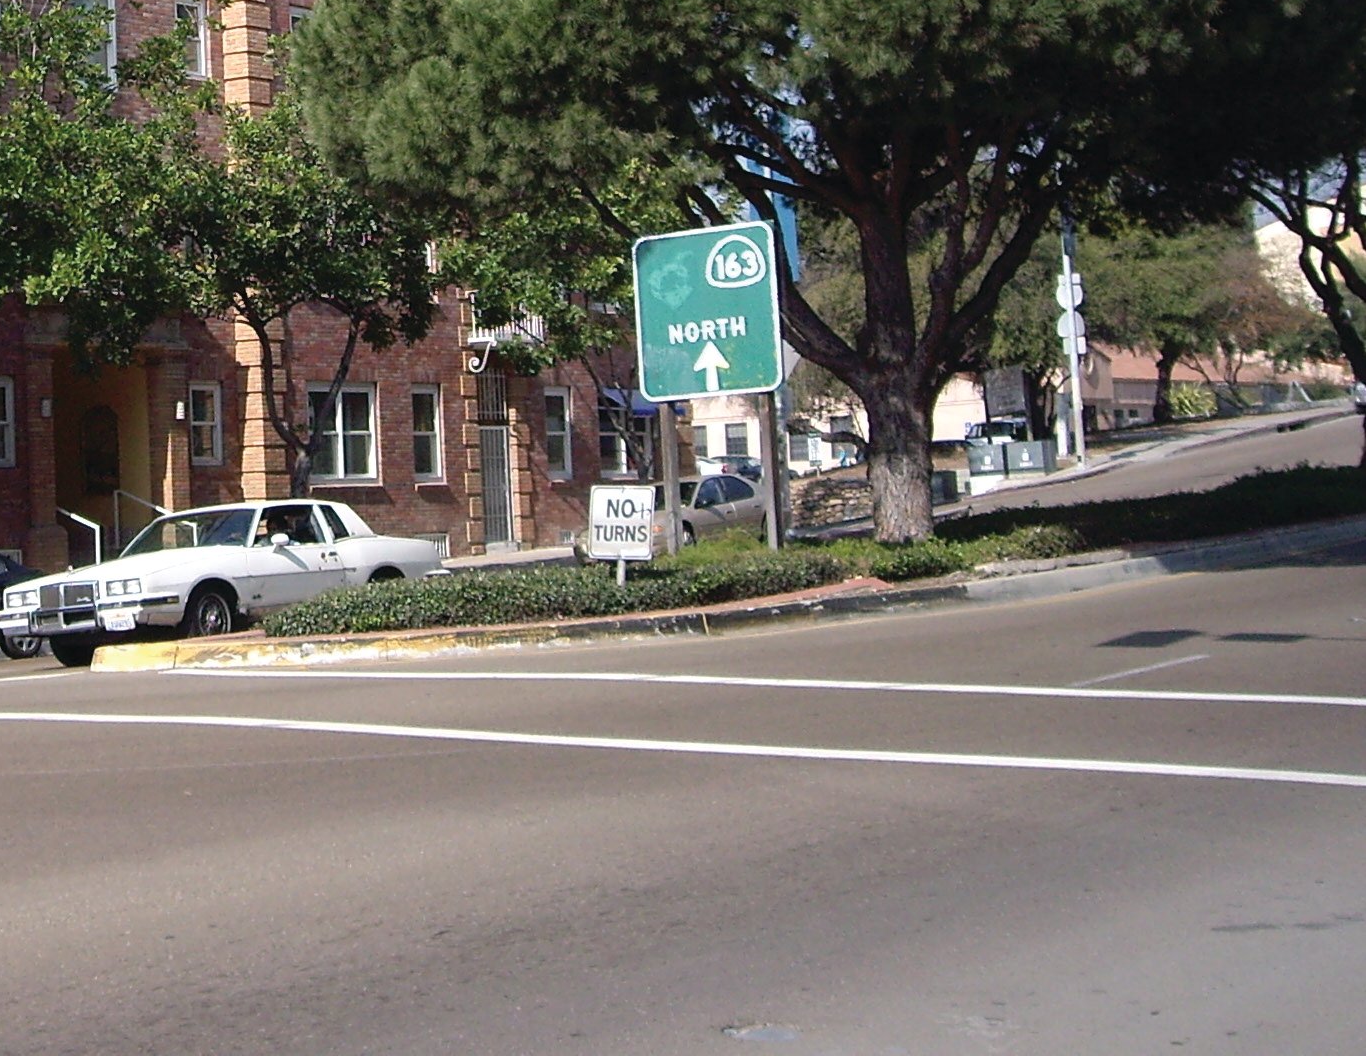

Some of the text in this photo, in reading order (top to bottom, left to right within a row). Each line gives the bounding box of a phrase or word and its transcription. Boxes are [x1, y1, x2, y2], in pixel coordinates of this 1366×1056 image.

[715, 249, 759, 280] 163
[667, 315, 747, 345] NORTH
[606, 498, 636, 519] NO
[594, 524, 648, 543] TURNS
